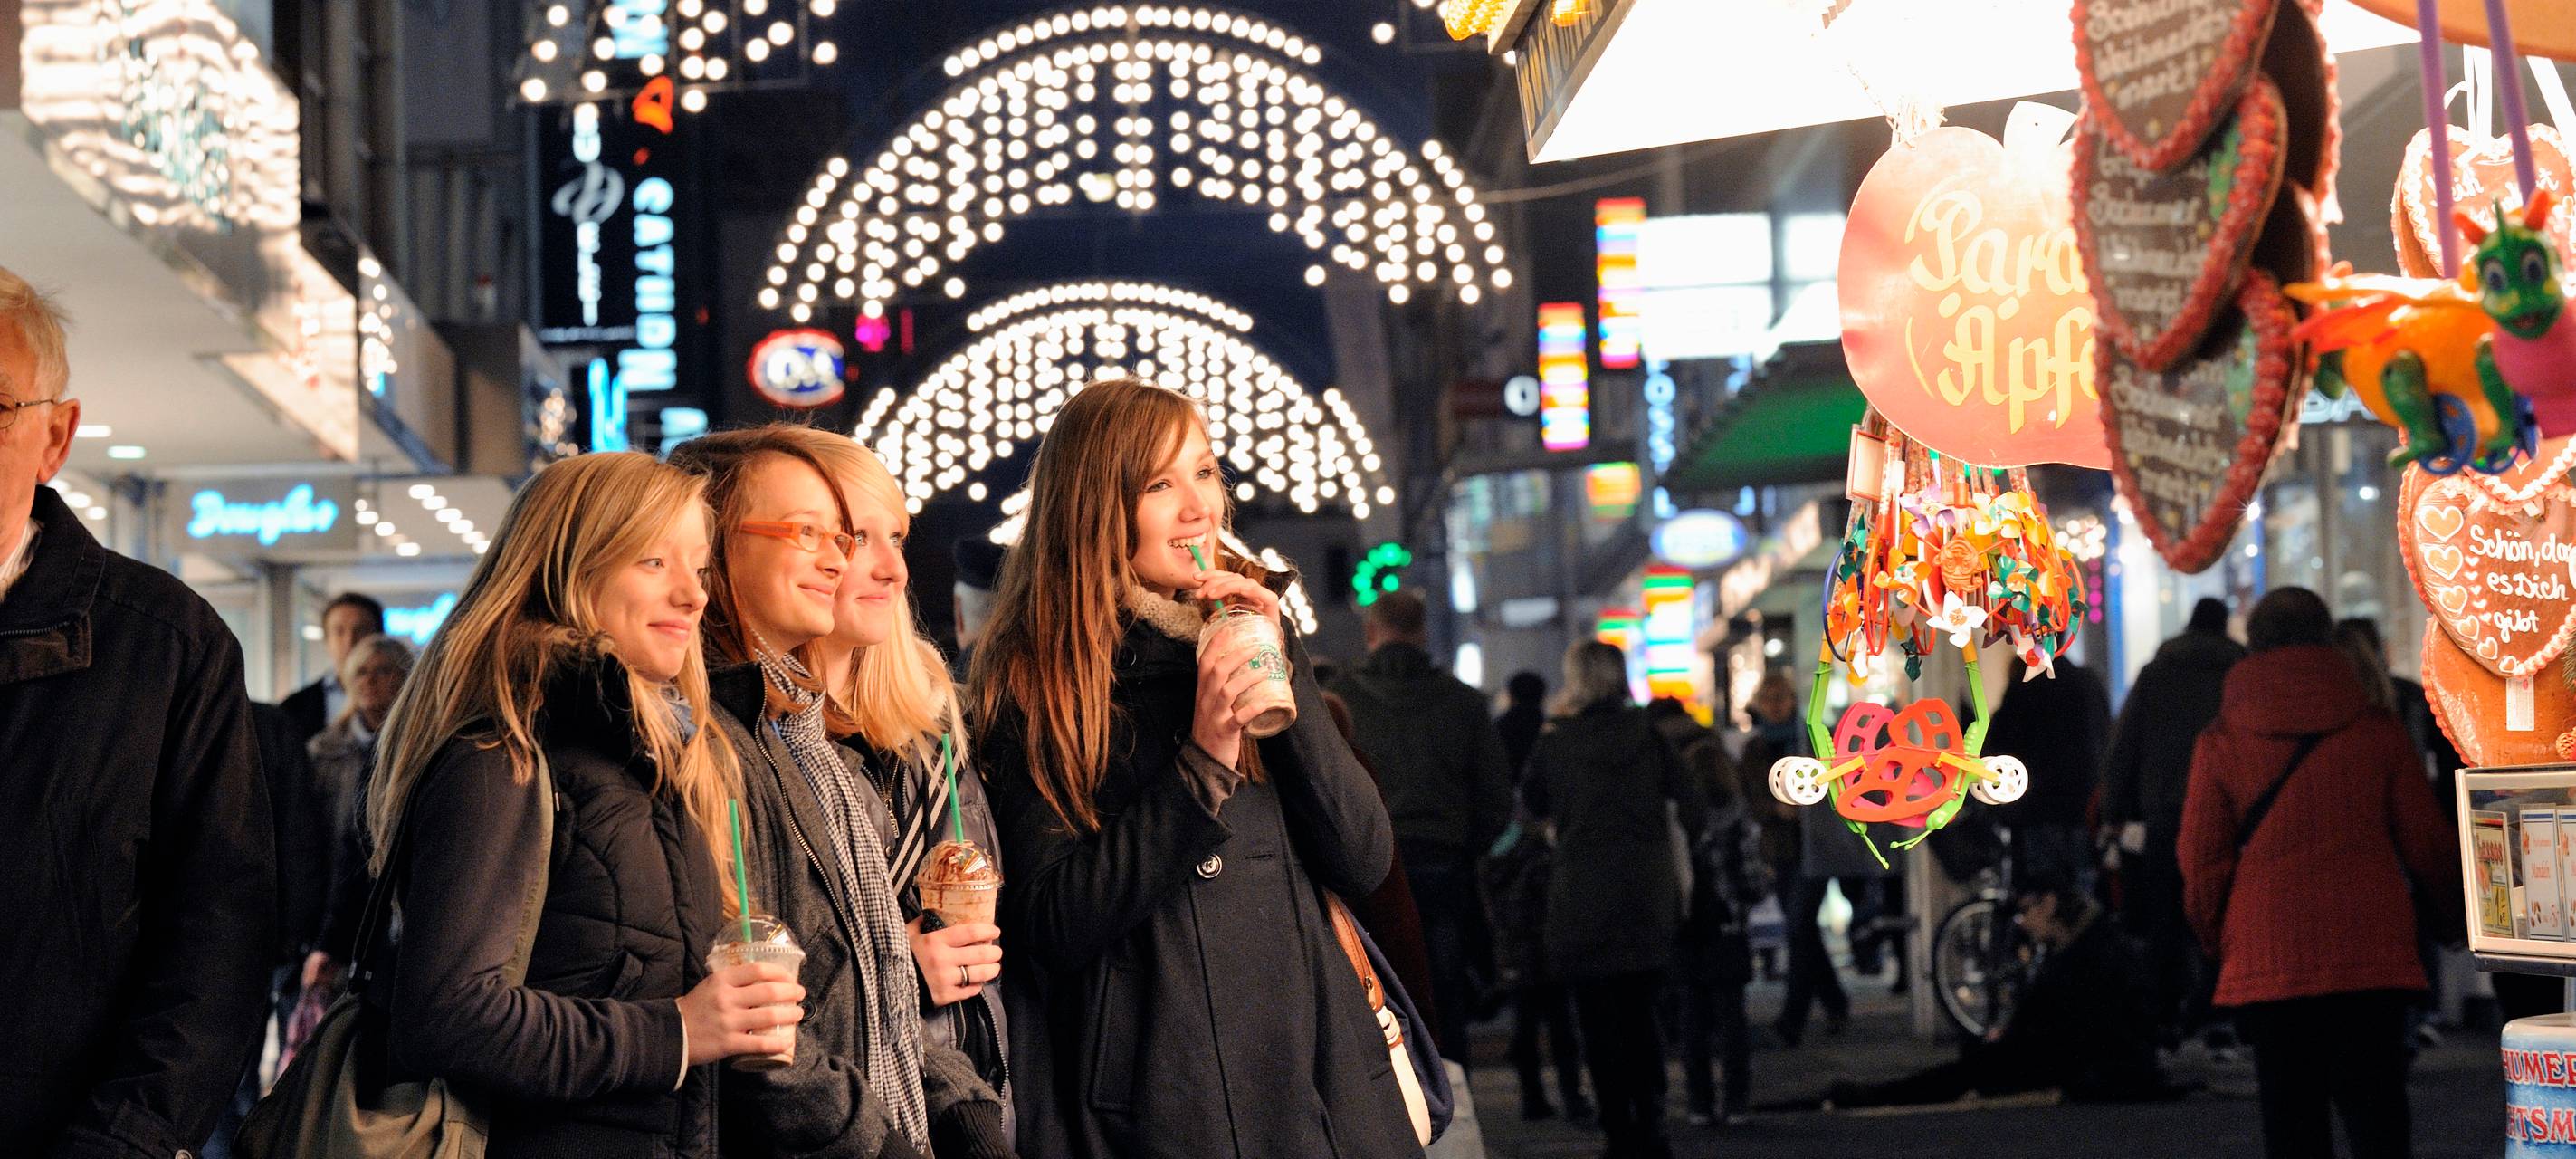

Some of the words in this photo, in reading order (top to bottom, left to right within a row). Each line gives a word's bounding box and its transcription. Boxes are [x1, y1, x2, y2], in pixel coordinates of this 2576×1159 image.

[2468, 524, 2540, 568] Schön,
[2486, 571, 2514, 595] es
[2512, 572, 2570, 601] Dich
[2493, 608, 2540, 643] gibt
